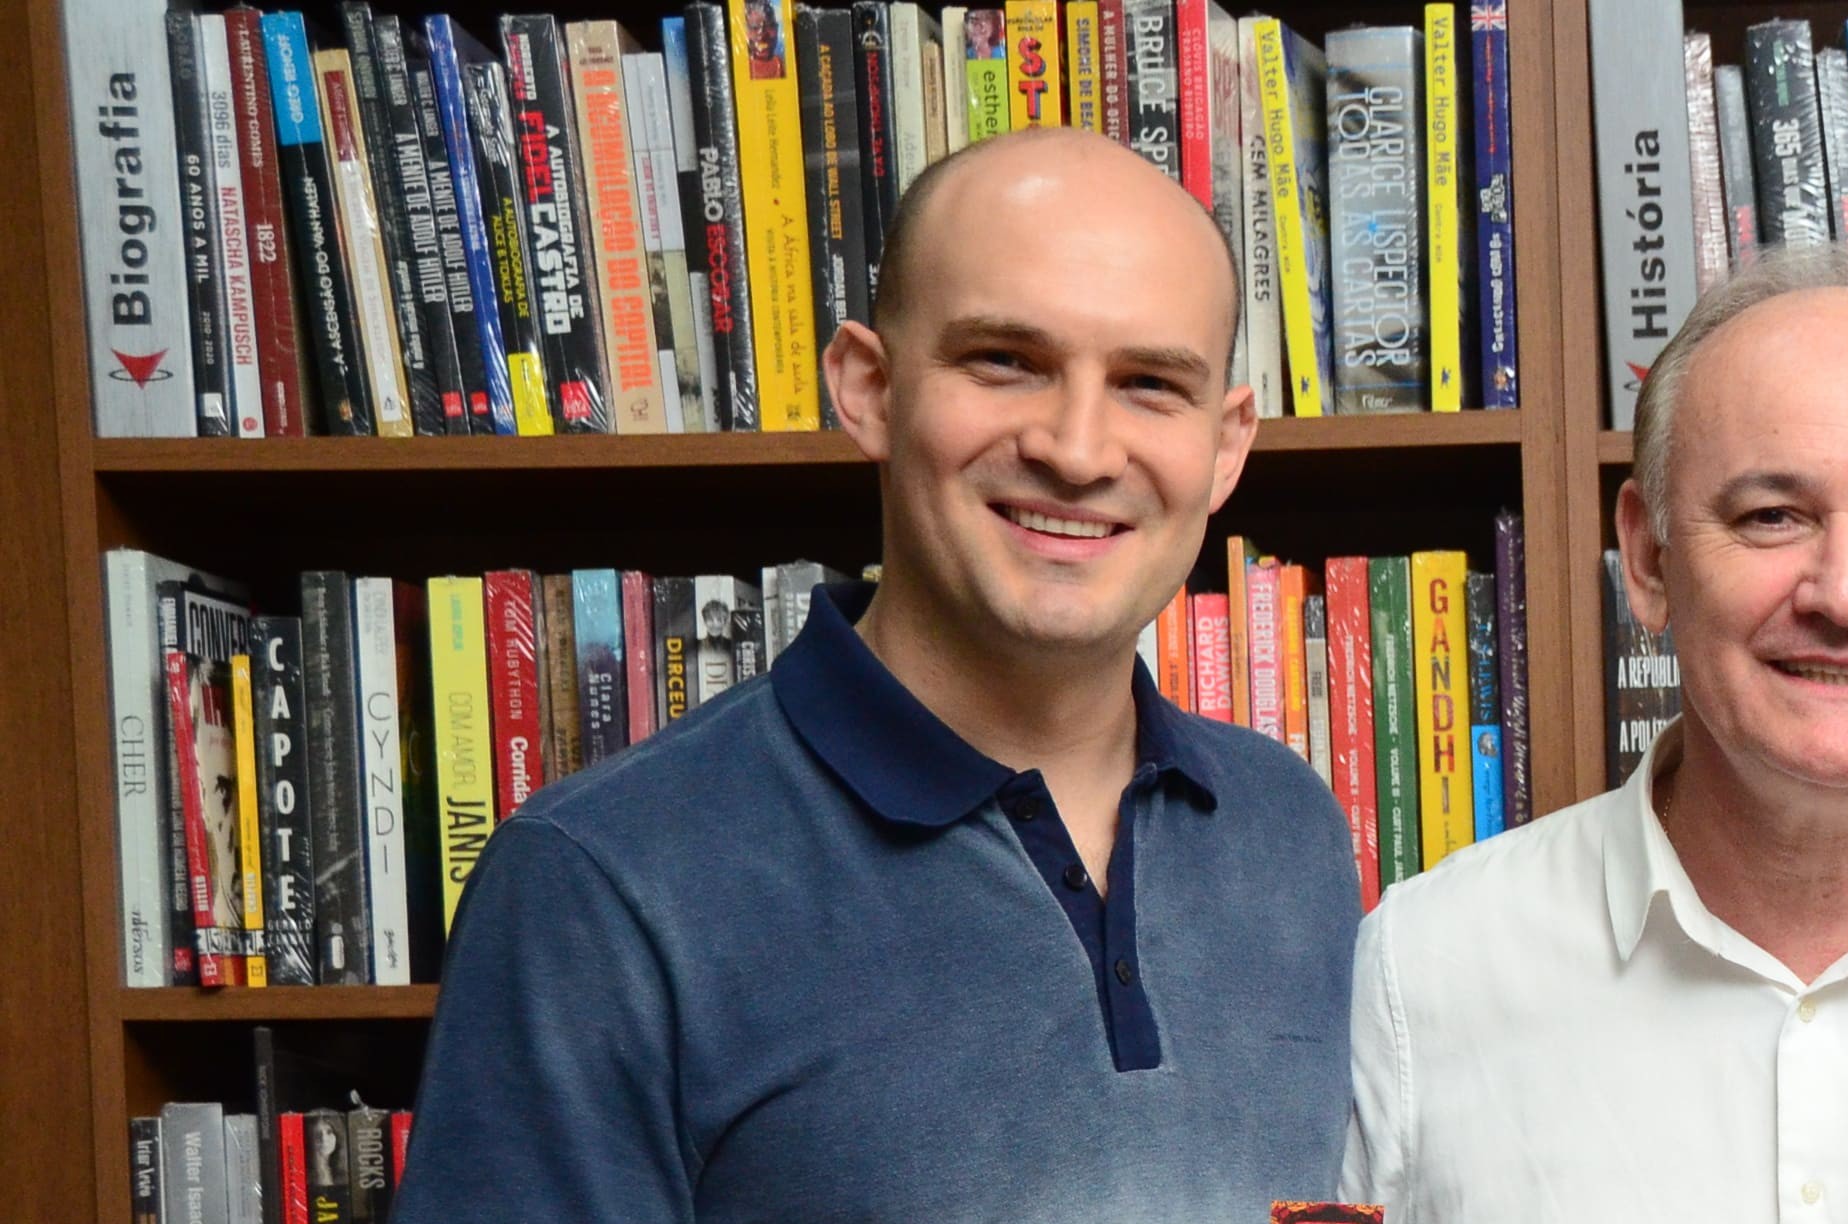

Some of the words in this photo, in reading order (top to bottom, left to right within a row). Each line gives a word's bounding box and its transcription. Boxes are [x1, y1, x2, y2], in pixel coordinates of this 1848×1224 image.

[1134, 16, 1168, 114] BRUCE
[1260, 31, 1279, 100] Valter
[1432, 17, 1450, 85] Valter
[211, 91, 229, 130] 3096
[545, 126, 560, 139] A
[1266, 108, 1286, 155] Hugo
[1337, 87, 1373, 198] TODAS
[1367, 86, 1405, 196] CLARICE
[1431, 96, 1449, 142] Hugo
[187, 155, 200, 176] 60
[216, 135, 232, 168] dias
[428, 161, 446, 169] A
[518, 111, 554, 204] FIDEL
[700, 148, 723, 221] PABLO
[1276, 163, 1292, 197] Mãe
[1436, 151, 1451, 186] Mãe
[99, 73, 156, 326] Biografia
[190, 184, 205, 230] ANOS
[430, 171, 456, 211] MENTE
[439, 214, 459, 229] DE
[548, 145, 579, 288] AUTOBIOGRAFIA
[194, 237, 206, 248] A
[220, 187, 242, 270] NATASCHA
[256, 224, 276, 262] 1822
[441, 233, 466, 270] ADOLF
[1341, 212, 1373, 246] AS
[1624, 129, 1668, 340] História
[195, 255, 209, 282] MIL
[450, 272, 473, 312] HITLER
[532, 203, 571, 334] CASTRO
[706, 225, 732, 333] ESCOBAR
[1372, 209, 1410, 367] LISPECTOR
[230, 275, 252, 365] KAMPUSCH
[568, 295, 584, 318] DE
[1343, 255, 1375, 367] CARTAS
[1250, 582, 1277, 664] FREDERICK
[666, 638, 686, 719] DIRCEU
[1199, 617, 1215, 711] RICHARD
[1215, 617, 1230, 709] DAWKINS
[1429, 578, 1455, 814] GANDHI
[120, 715, 147, 798] CHER
[267, 637, 297, 911] CAPOTE
[367, 692, 395, 875] CYNDI
[509, 736, 530, 805] Corrida
[445, 796, 487, 884] JANIS
[356, 1128, 384, 1189] ROCKS
